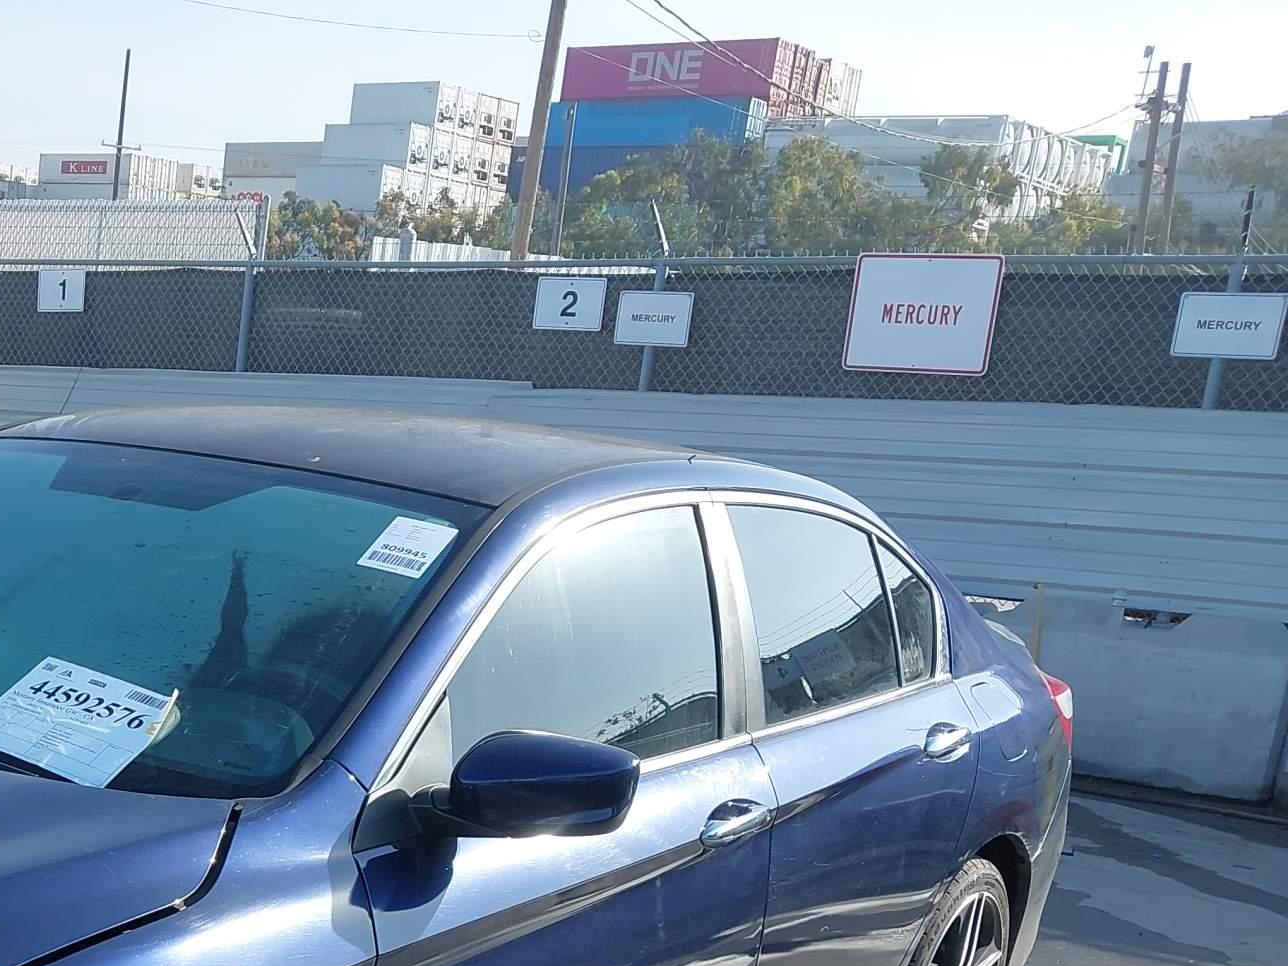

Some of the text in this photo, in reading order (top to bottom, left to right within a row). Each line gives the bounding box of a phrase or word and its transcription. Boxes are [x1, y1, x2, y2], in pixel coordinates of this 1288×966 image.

[629, 50, 704, 81] ONE
[58, 279, 67, 301] 1
[559, 290, 579, 317] 2
[881, 303, 963, 326] MERCURY
[630, 313, 677, 324] MERCURY
[1196, 319, 1262, 331] MERCURY
[380, 543, 428, 559] 809945
[28, 680, 153, 730] 44592576
